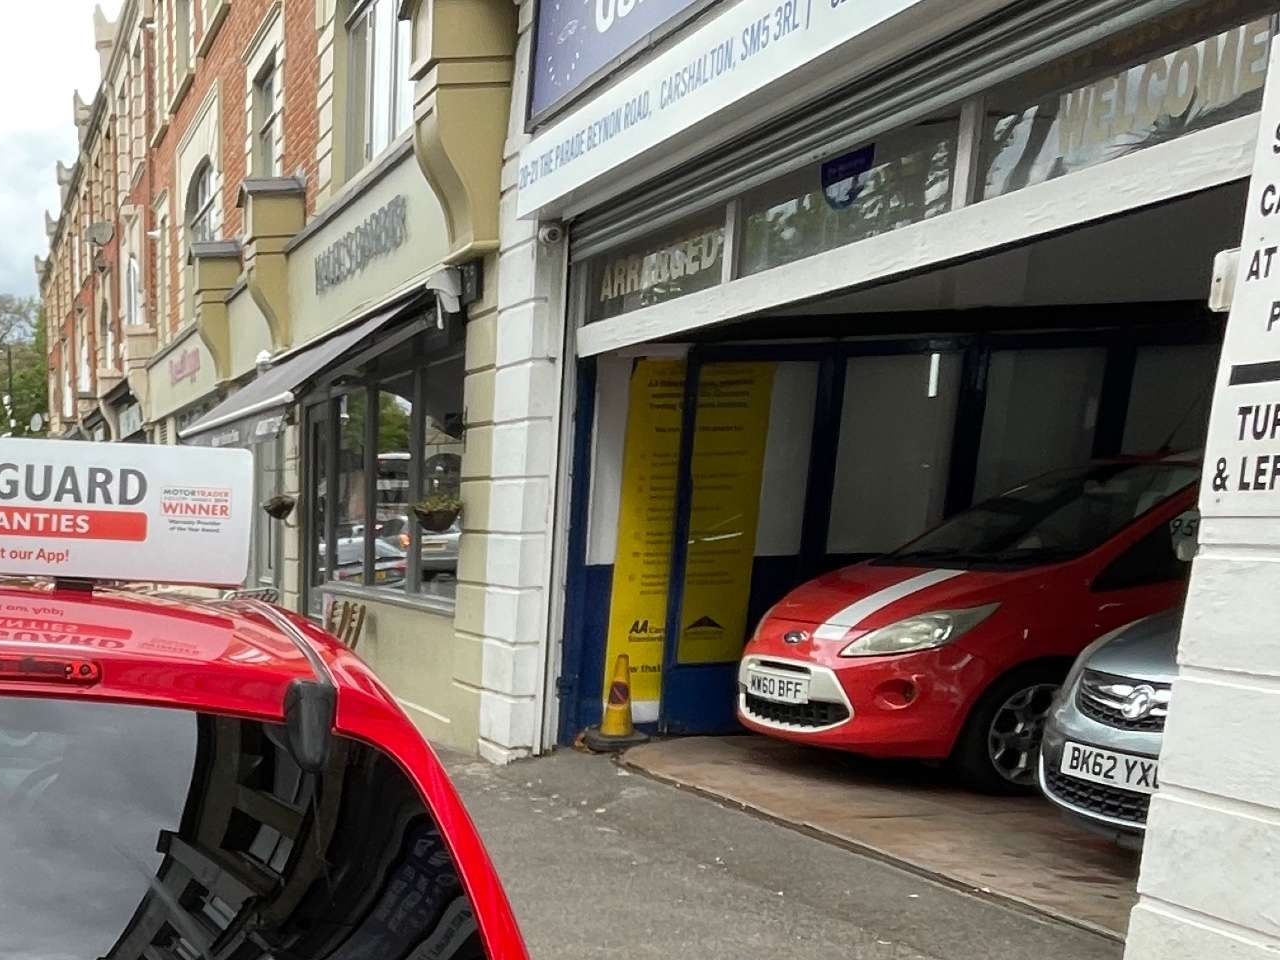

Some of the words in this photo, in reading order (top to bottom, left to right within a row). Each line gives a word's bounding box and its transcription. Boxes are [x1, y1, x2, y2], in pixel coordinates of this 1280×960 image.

[554, 129, 585, 170] PARADE
[660, 37, 736, 109] CARSHALTON,
[741, 13, 770, 61] SM5
[773, 0, 800, 42] 3RL
[1058, 16, 1270, 150] WELCOME
[1246, 246, 1278, 281] AT
[1213, 457, 1229, 492] &
[163, 502, 229, 517] WINNER
[10, 549, 33, 560] our
[36, 549, 70, 564] App!
[778, 680, 803, 698] BFF
[1069, 746, 1118, 780] BK62
